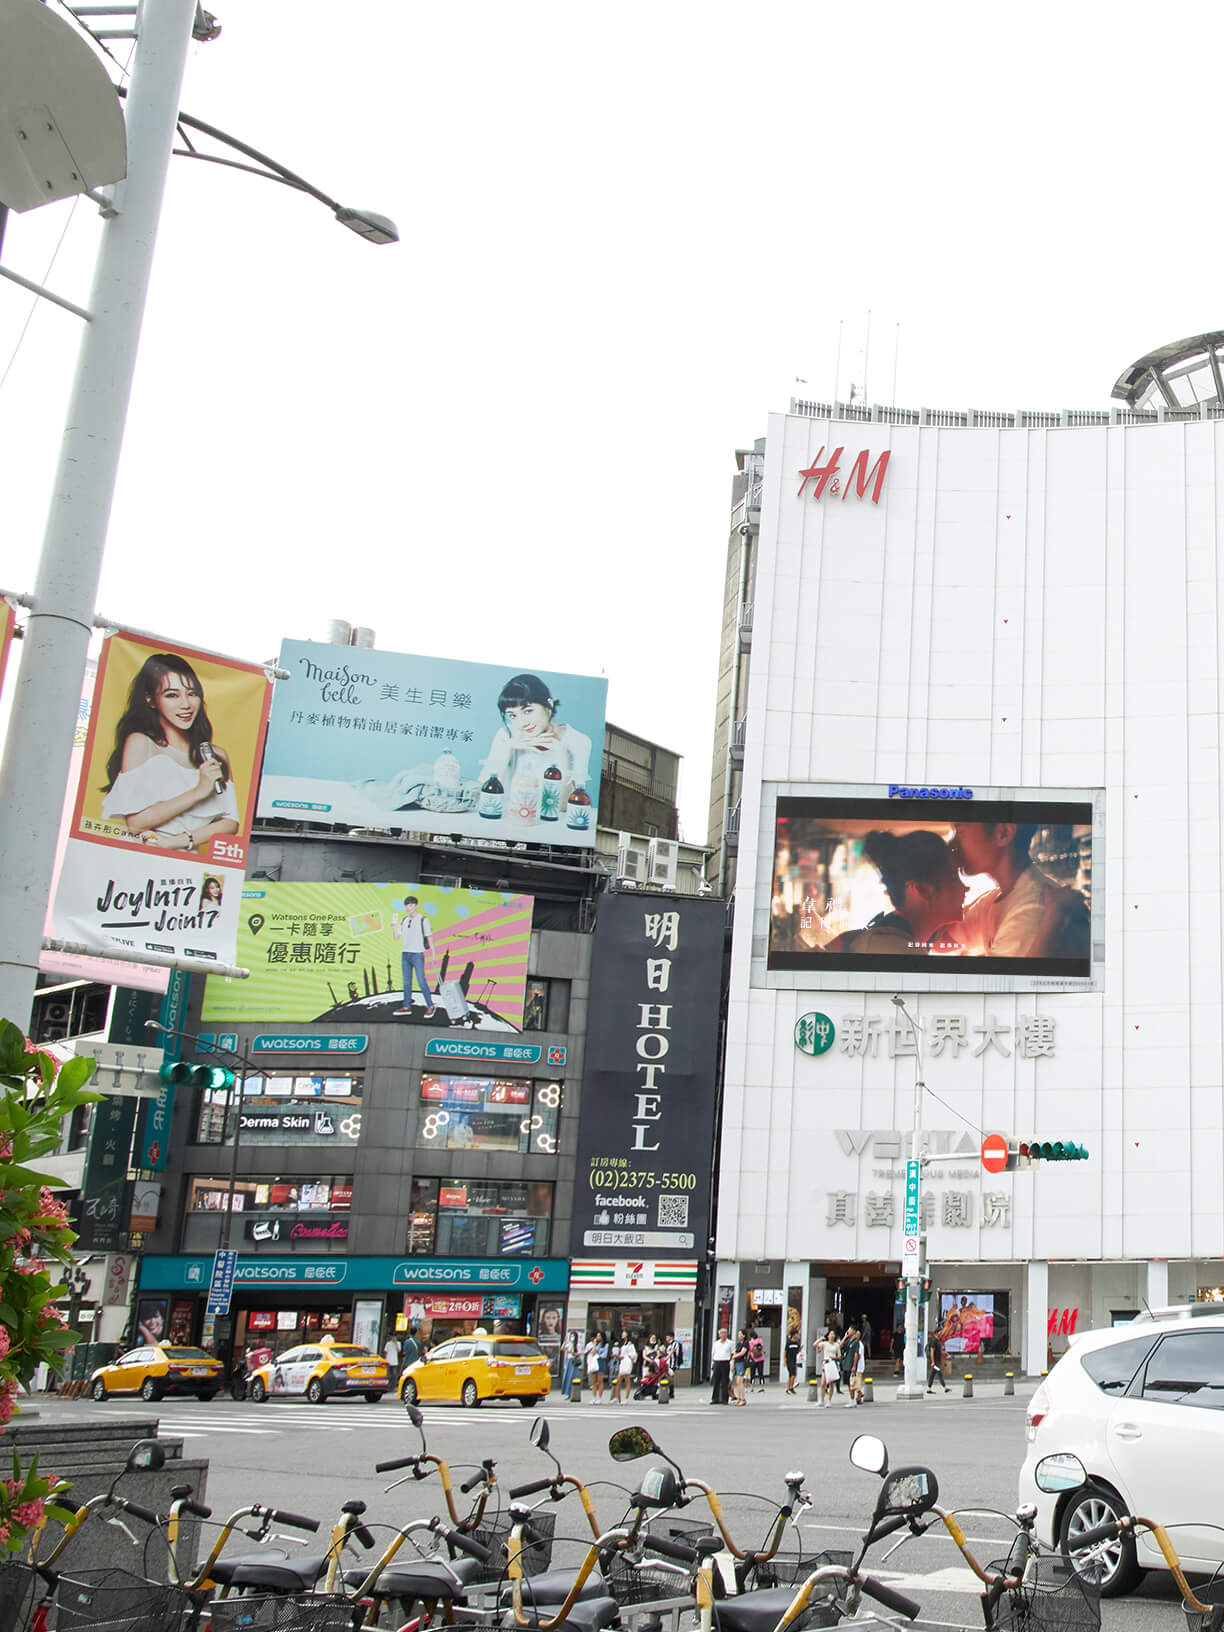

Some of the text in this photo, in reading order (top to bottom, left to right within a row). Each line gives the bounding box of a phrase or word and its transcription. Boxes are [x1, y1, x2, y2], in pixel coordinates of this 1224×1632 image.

[798, 446, 891, 504] H&M
[320, 684, 361, 705] belle
[379, 683, 472, 710] 美生貝樂
[289, 709, 475, 743] 丹麥植物精油居家清潔專家
[888, 785, 974, 800] Panasonic
[213, 840, 244, 860] 5th
[97, 878, 197, 917] JoyIn17
[154, 910, 219, 931] Join17
[271, 913, 308, 922] Watsons
[269, 923, 334, 937] 一卡隨享
[266, 941, 361, 965] 優惠隨行
[261, 1037, 358, 1049] watsons 屈臣氏
[839, 1014, 1057, 1058] 新世界大樓
[435, 1041, 533, 1059] watsons 屈臣氏
[630, 1003, 673, 1151] HOTEL
[239, 1115, 310, 1128] Derma Skin
[589, 1168, 697, 1191] (02)2375-5500
[948, 1168, 981, 1179] MEDIA
[595, 1193, 647, 1208] facebook
[591, 1232, 645, 1245] 明日大飯店
[233, 1266, 337, 1279] watsons 屈臣氏
[403, 1266, 511, 1280] watsons 屈臣氏
